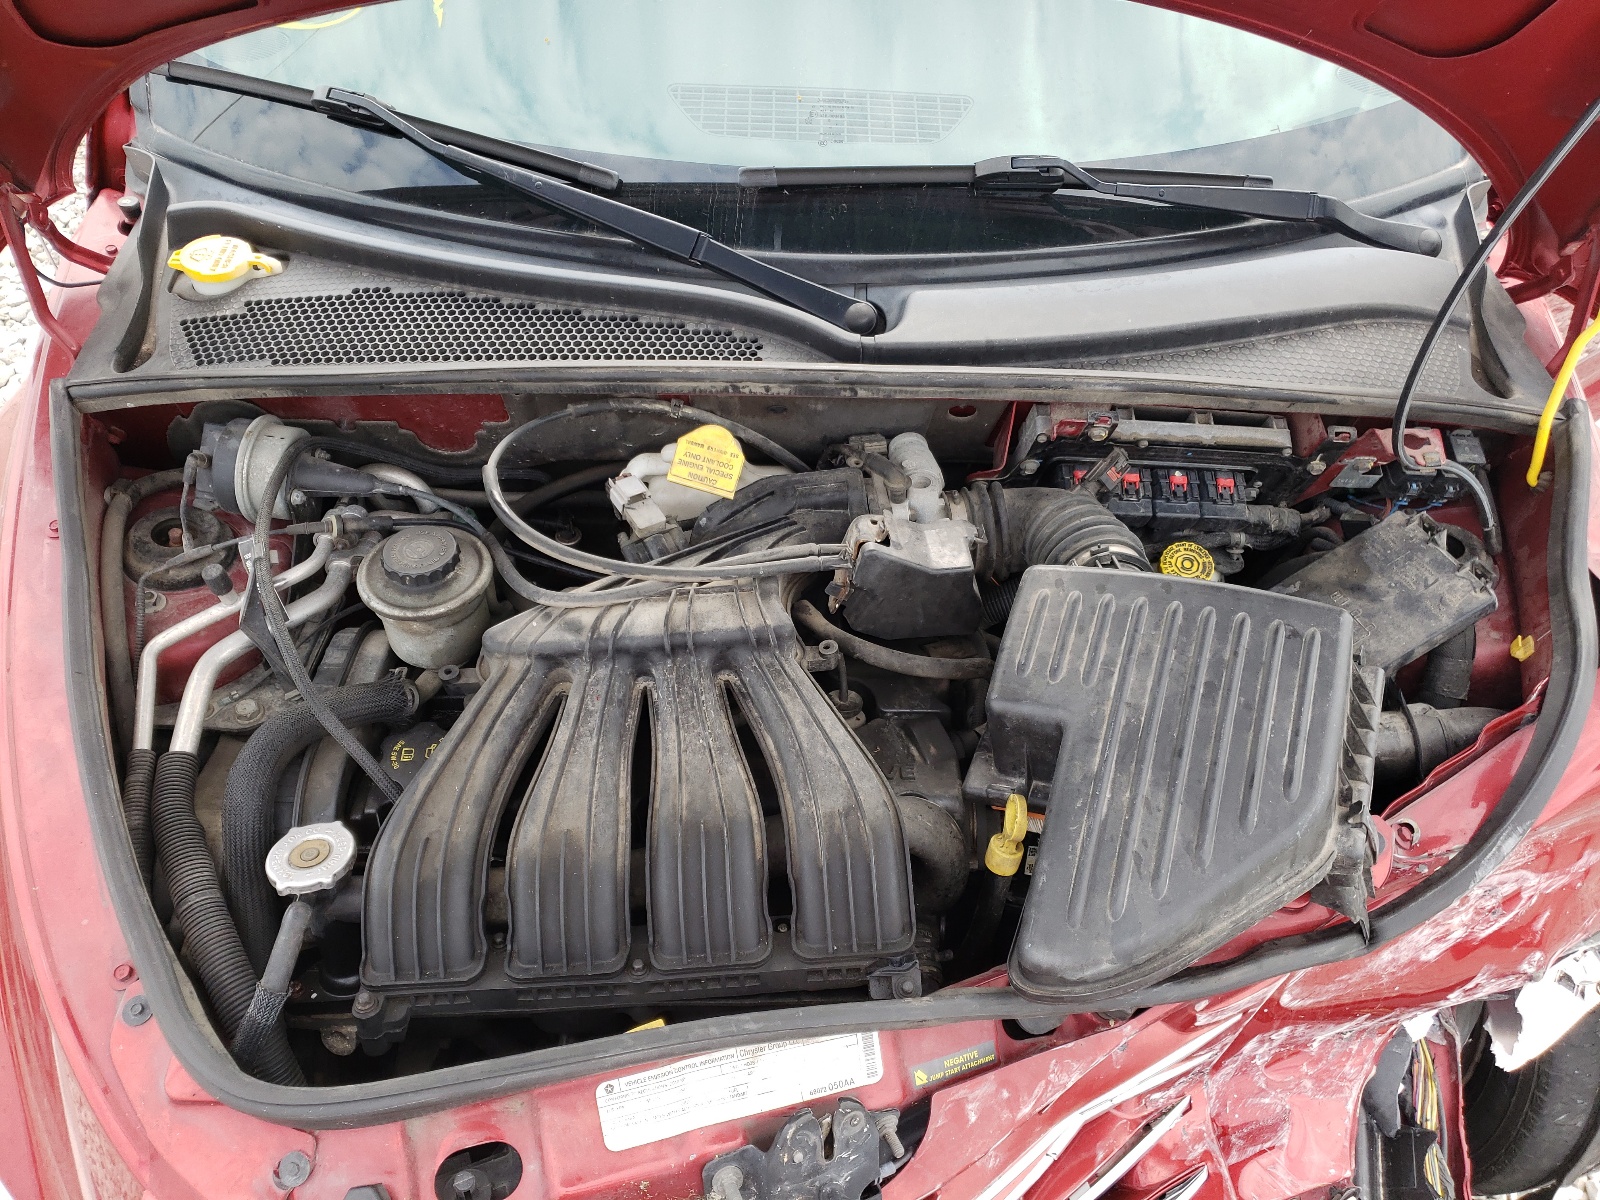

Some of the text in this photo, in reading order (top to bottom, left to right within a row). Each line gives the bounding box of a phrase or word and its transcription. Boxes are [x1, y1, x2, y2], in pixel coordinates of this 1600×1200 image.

[677, 458, 734, 480] SPECIAL ENGINE
[683, 451, 734, 471] COOLANT ONLY
[688, 472, 718, 485] CAUTION
[624, 1077, 647, 1087] VEHICLE
[647, 1071, 674, 1082] EMISSION
[674, 1064, 698, 1075] CONTROL
[699, 1054, 734, 1068] INFORMATION
[739, 1045, 767, 1057] Chrysler
[767, 1041, 788, 1051] Group
[930, 1054, 995, 1081] JUMP START ATTACHMENT
[944, 1050, 979, 1068] NEGATIVE
[828, 1077, 856, 1092] 050AA
